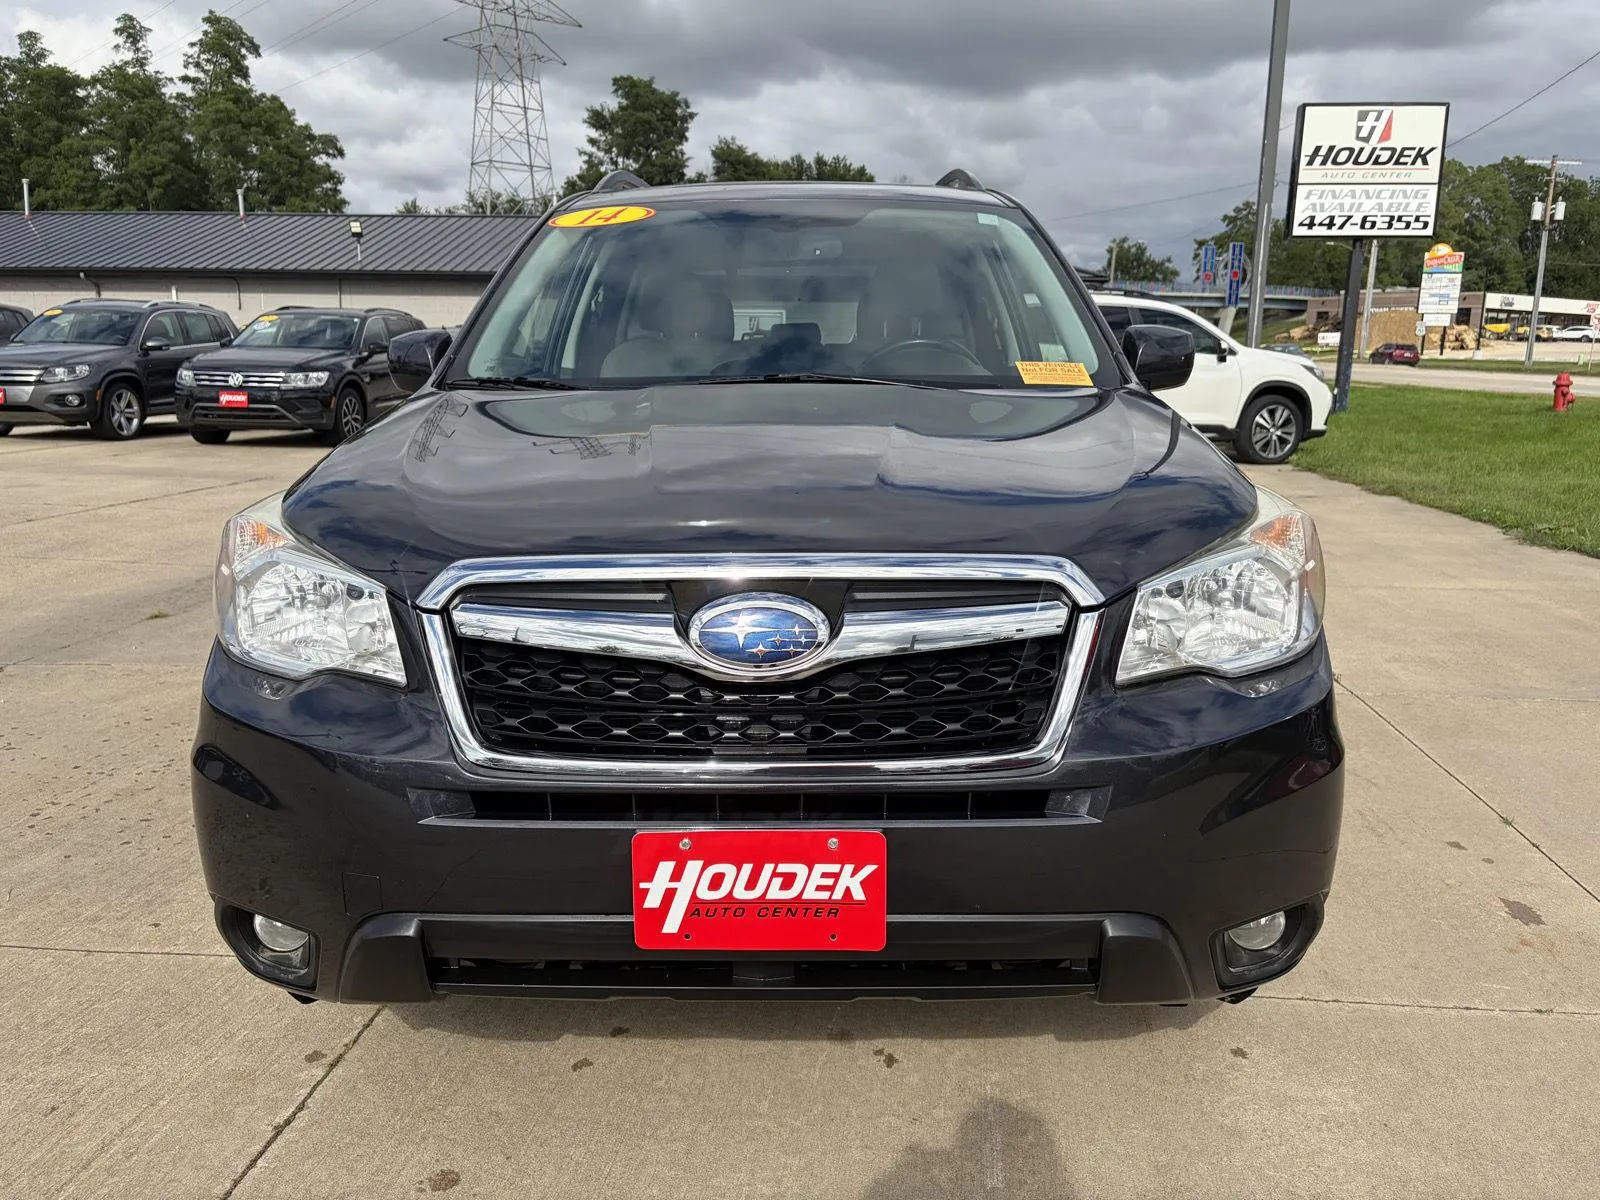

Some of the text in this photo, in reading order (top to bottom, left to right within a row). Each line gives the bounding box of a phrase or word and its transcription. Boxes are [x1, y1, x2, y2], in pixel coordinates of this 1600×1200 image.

[1304, 145, 1438, 167] HOUDEK
[1303, 189, 1430, 201] FINANCING
[575, 207, 628, 225] 14
[1301, 202, 1430, 213] AVAILABLE
[1298, 214, 1431, 231] 447-6355
[639, 860, 879, 934] HOUDEK
[689, 907, 840, 918] AUTO CENTER
